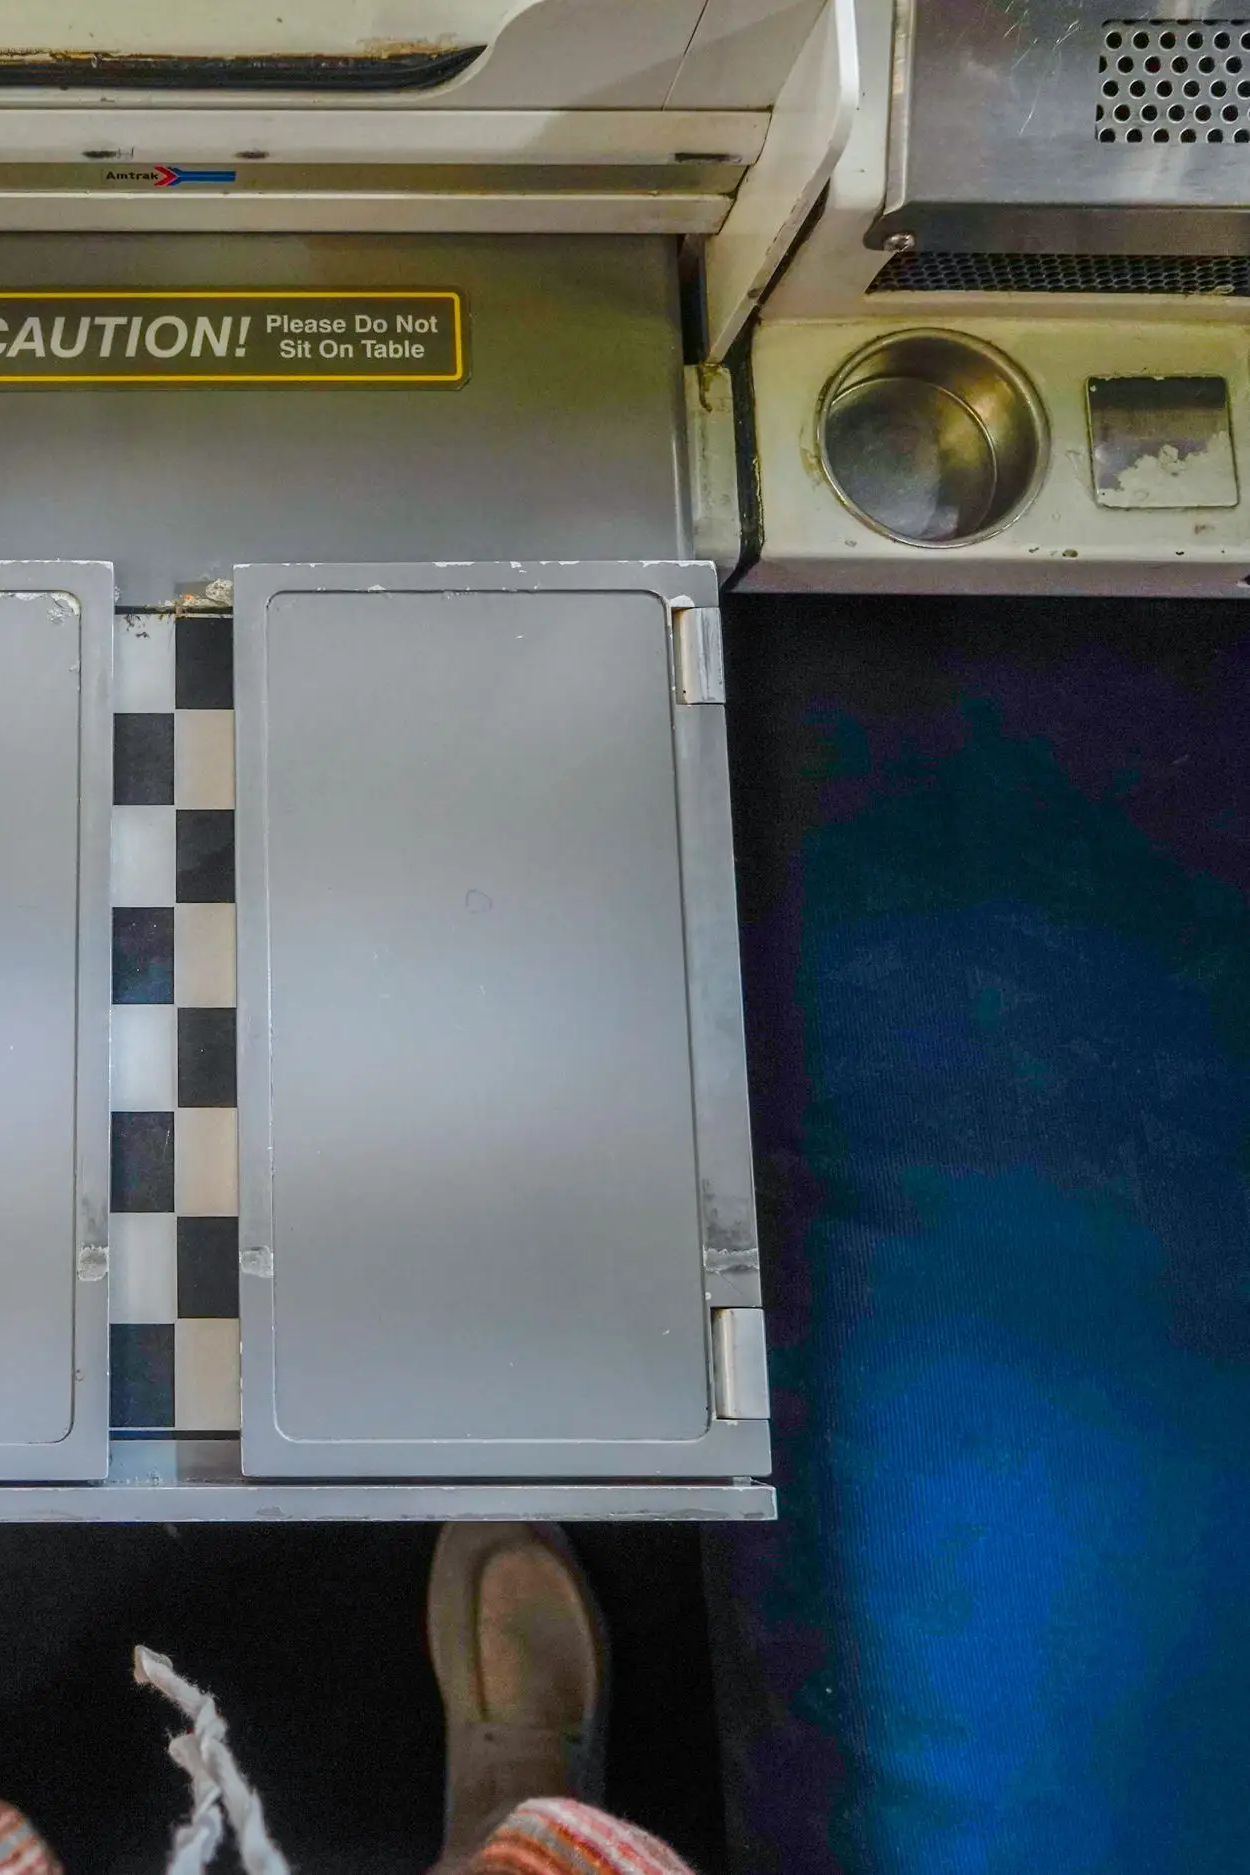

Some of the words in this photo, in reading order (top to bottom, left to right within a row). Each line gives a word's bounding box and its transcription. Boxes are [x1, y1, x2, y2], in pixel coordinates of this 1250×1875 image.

[106, 171, 159, 180] Amtrak
[266, 314, 346, 333] Please
[354, 315, 388, 333] Do
[396, 315, 438, 333] Not
[280, 339, 312, 359] Sit
[319, 339, 352, 359] On
[360, 339, 425, 359] Table
